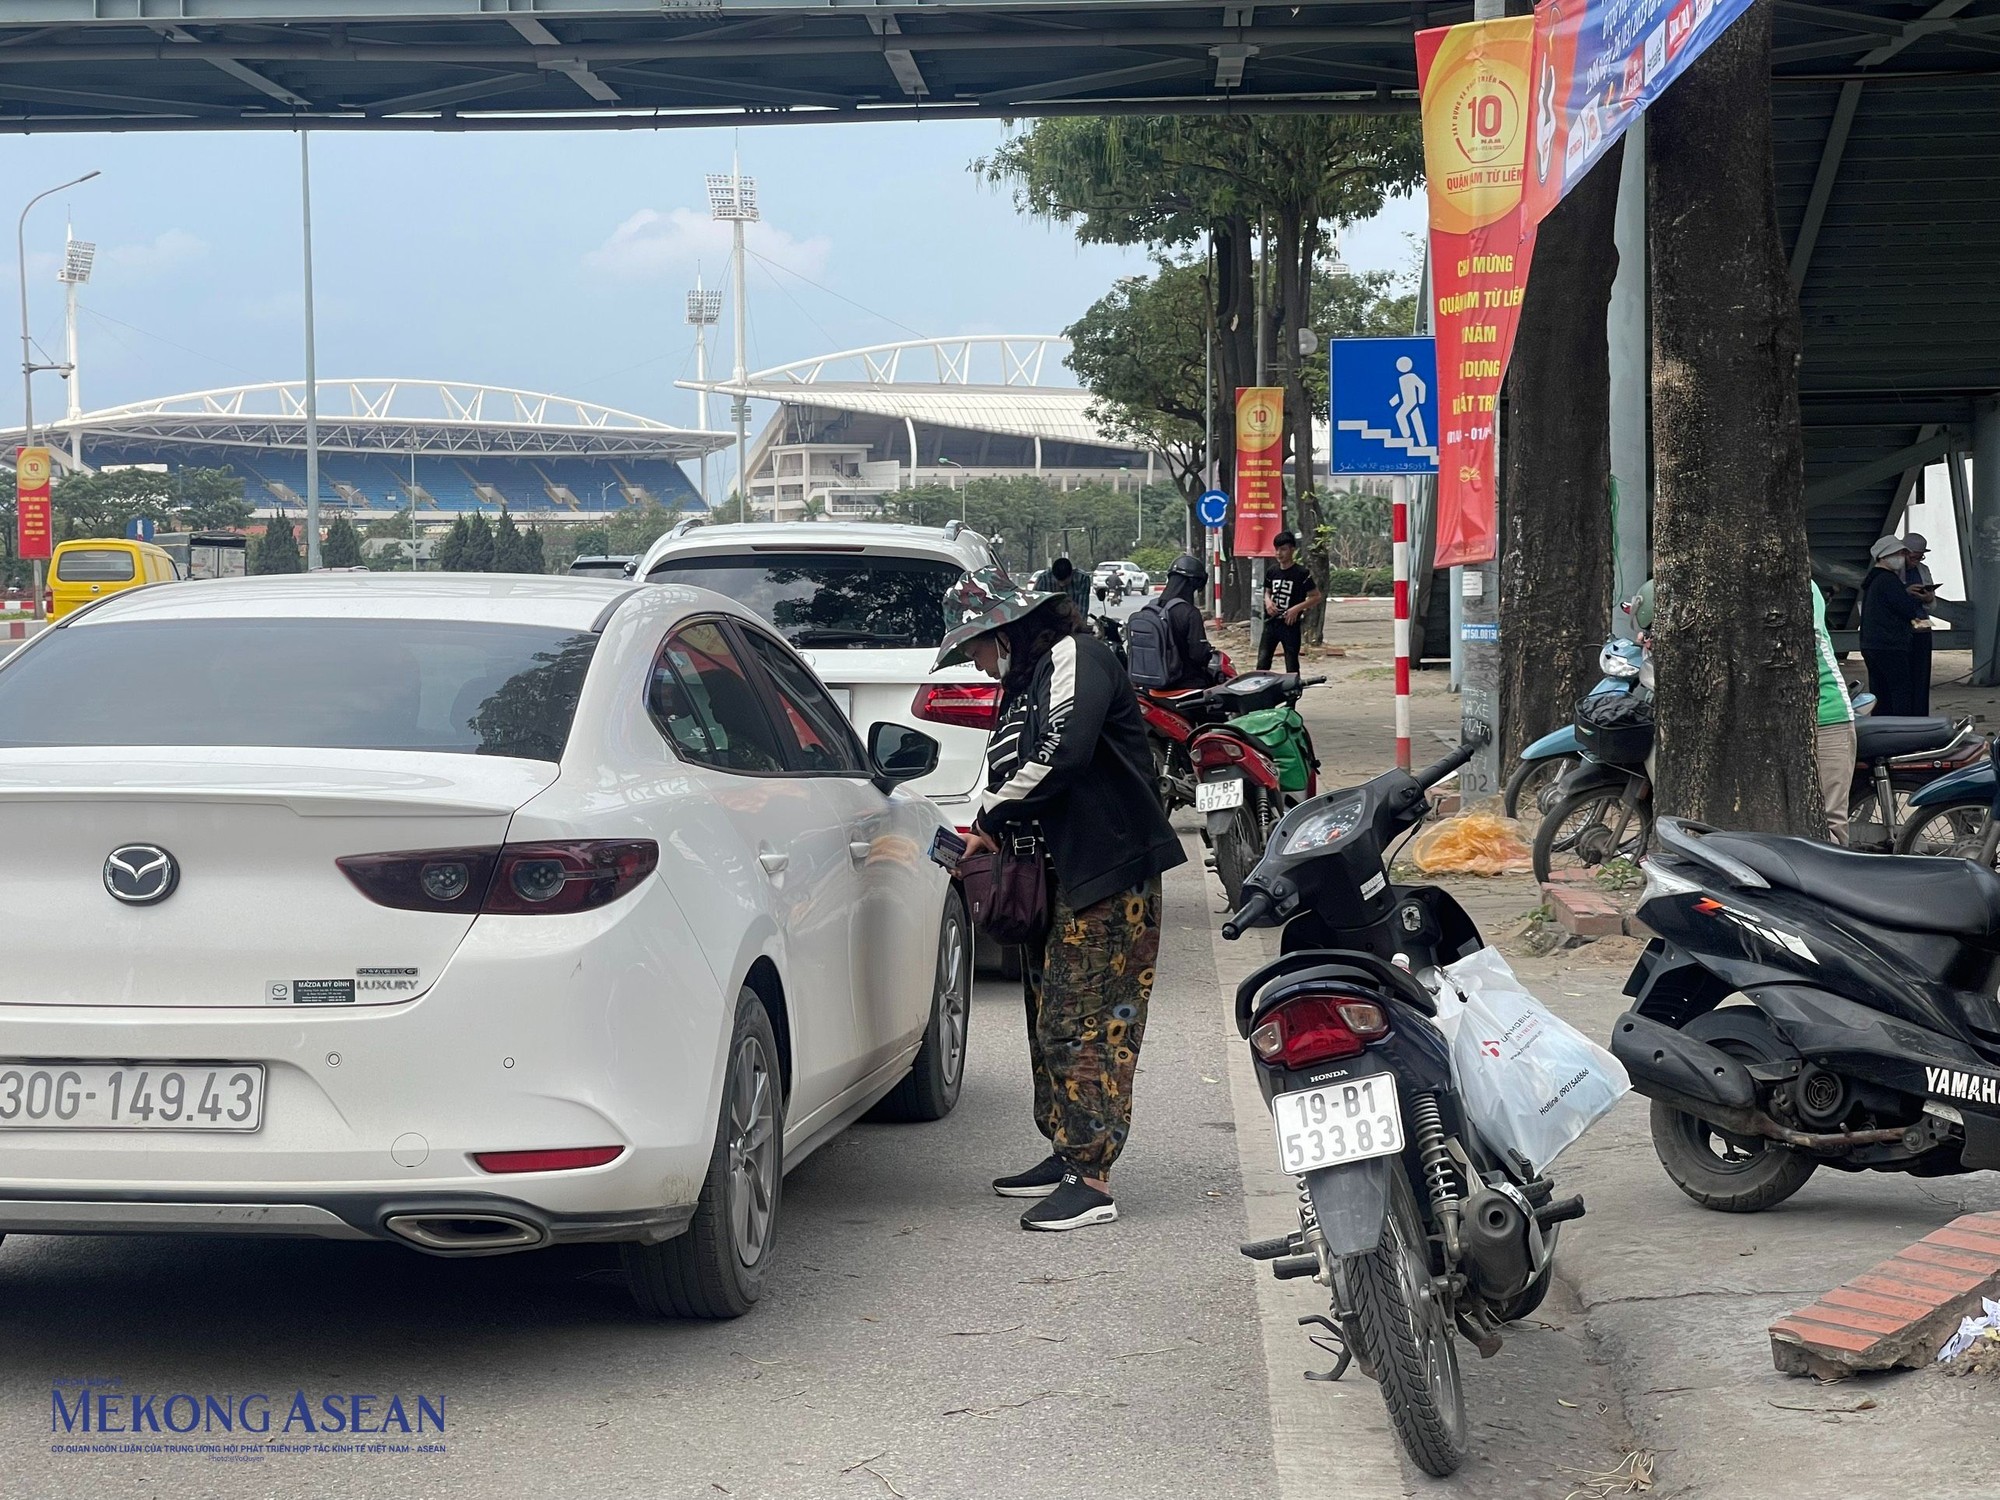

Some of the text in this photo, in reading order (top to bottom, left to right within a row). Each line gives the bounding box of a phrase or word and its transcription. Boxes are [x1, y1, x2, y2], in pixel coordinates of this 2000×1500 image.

[1467, 95, 1502, 138] 10
[1487, 168, 1500, 183] TỪ
[1472, 252, 1514, 274] MỪNG
[1483, 287, 1503, 308] TỪ
[1464, 322, 1497, 343] NĂM
[1464, 358, 1501, 381] DỰNG
[1253, 410, 1267, 423] 10
[1204, 781, 1236, 797] 17-B5
[1199, 793, 1239, 811] 687.27
[356, 980, 419, 990] LUXURY
[1310, 1069, 1349, 1083] HONDA
[1925, 1066, 2000, 1105] YAMAH
[0, 1070, 255, 1123] 30G-149.43
[1296, 1081, 1376, 1128] 19-B1
[1286, 1115, 1396, 1167] 533.83
